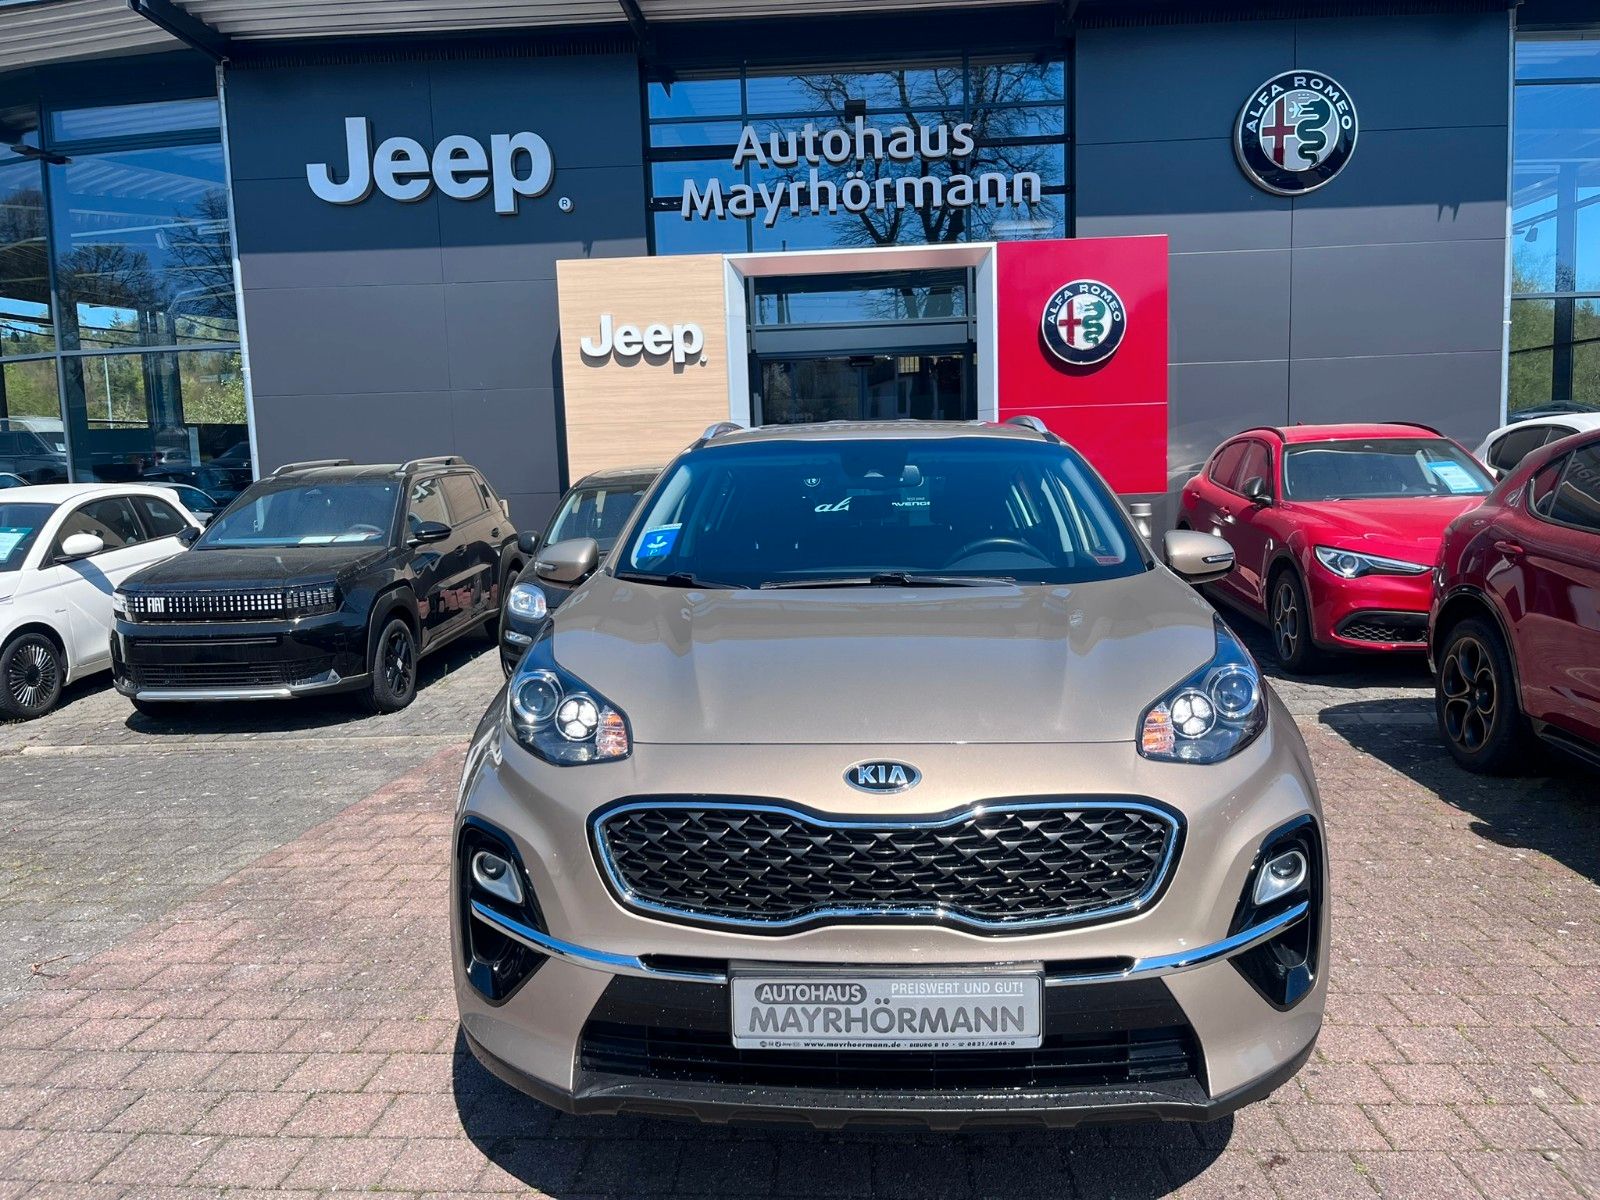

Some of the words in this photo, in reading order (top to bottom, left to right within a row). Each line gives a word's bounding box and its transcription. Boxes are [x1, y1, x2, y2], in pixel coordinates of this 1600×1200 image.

[1245, 83, 1284, 134] ALFA
[1293, 76, 1353, 130] ROMEO
[732, 115, 975, 167] Autohaus
[306, 116, 553, 214] Jeep
[681, 169, 1042, 226] Mayrhörmann
[1047, 289, 1073, 324] ALFA
[1079, 284, 1122, 322] ROMEO
[580, 313, 704, 363] Jeep
[147, 597, 165, 613] FIAT
[857, 765, 908, 784] KIA
[760, 985, 862, 1002] AUTOHAUS
[892, 982, 960, 994] PREISWERT
[964, 982, 990, 993] UND
[995, 981, 1024, 993] GUT!
[749, 998, 1025, 1034] MAYRHÖRMANN
